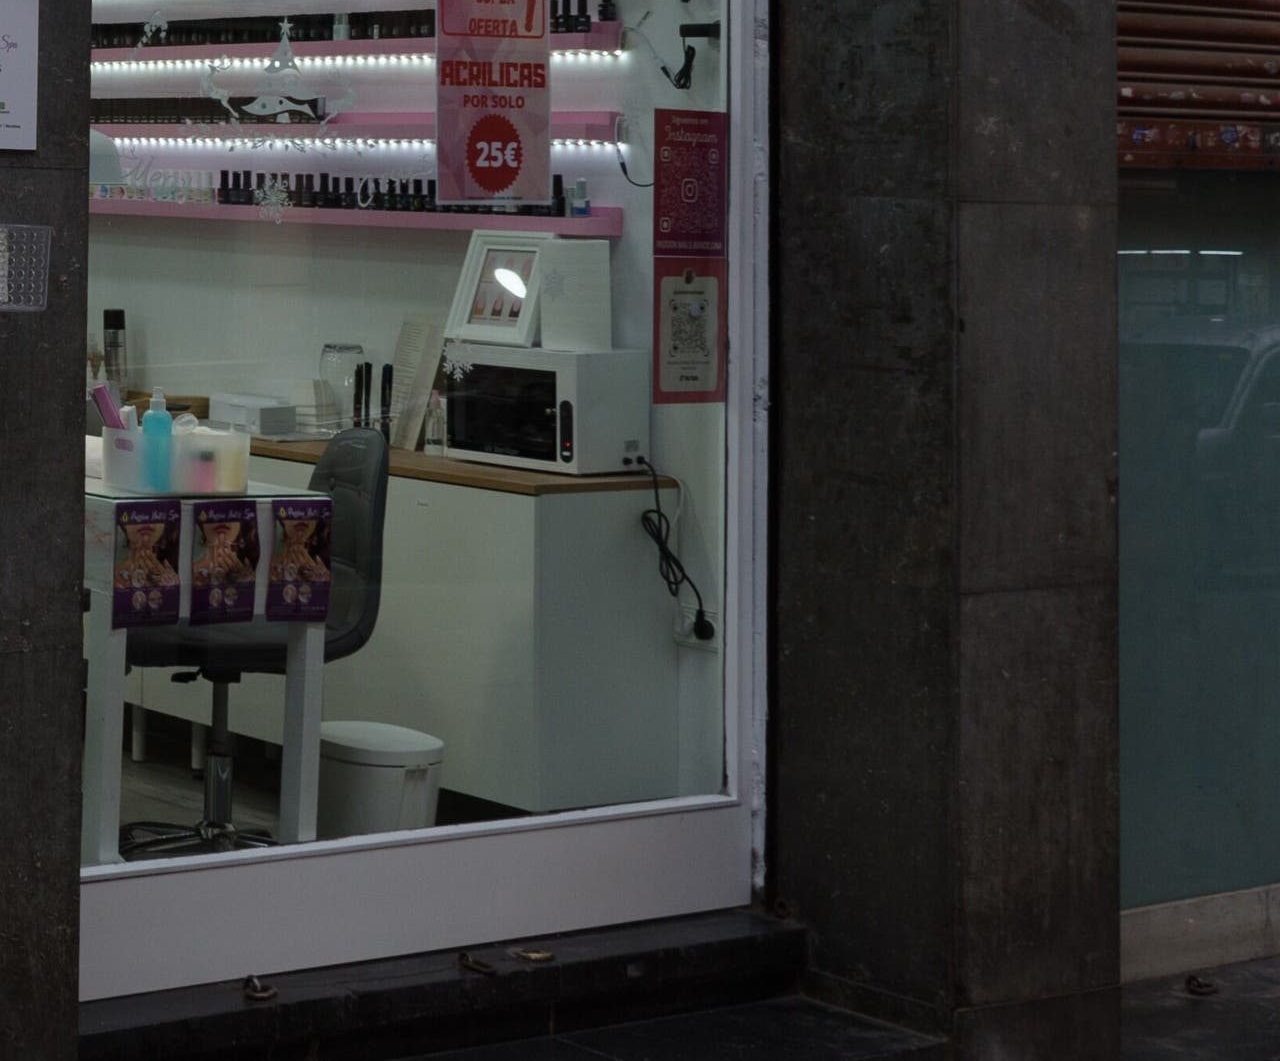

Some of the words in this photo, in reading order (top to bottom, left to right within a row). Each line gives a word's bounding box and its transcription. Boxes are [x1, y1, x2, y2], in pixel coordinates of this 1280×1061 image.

[469, 18, 519, 36] OFERTA
[441, 60, 546, 88] ACRILICAS
[463, 95, 488, 108] POR
[492, 95, 525, 109] SOLO
[664, 125, 718, 147] Instagram
[475, 141, 519, 168] 25€
